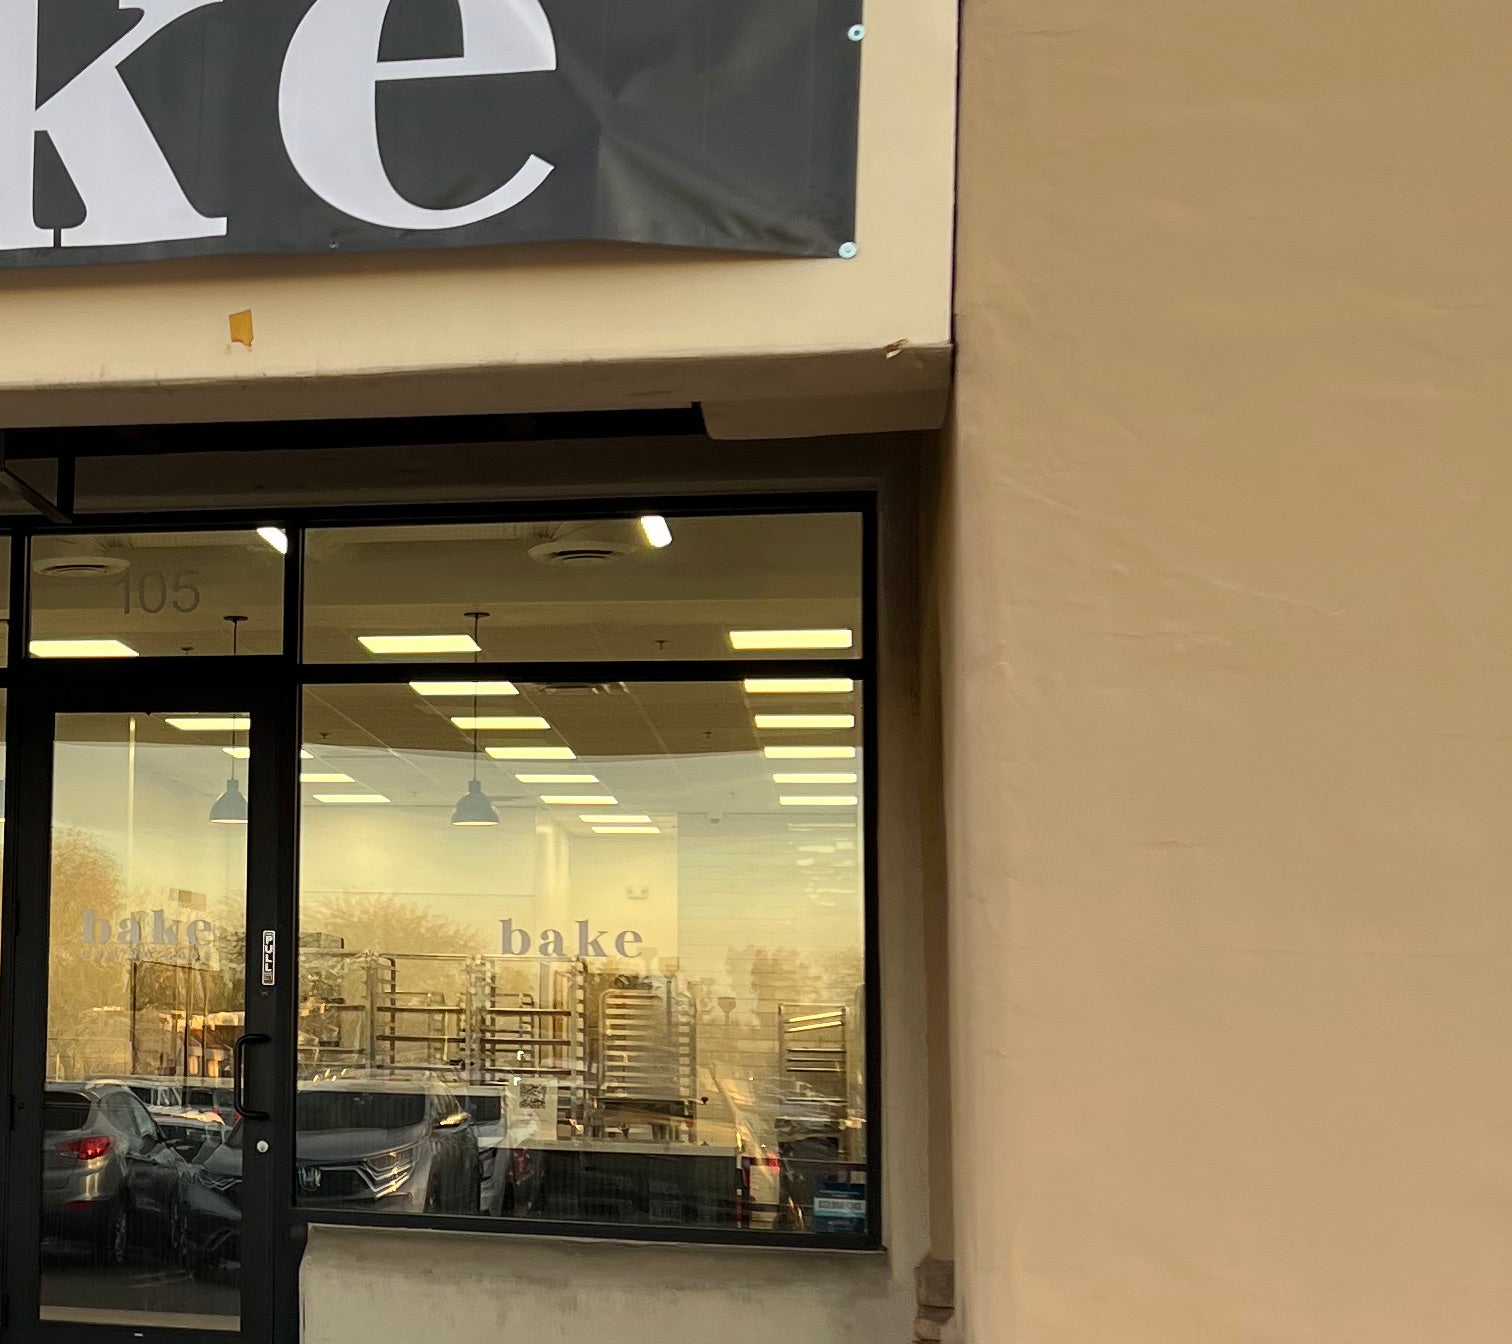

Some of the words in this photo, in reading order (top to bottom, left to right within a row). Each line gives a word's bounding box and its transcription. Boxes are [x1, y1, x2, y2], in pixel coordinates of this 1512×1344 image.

[117, 570, 200, 614] 105
[81, 908, 213, 946] bake
[498, 918, 643, 958] bake
[264, 935, 274, 972] PULL
